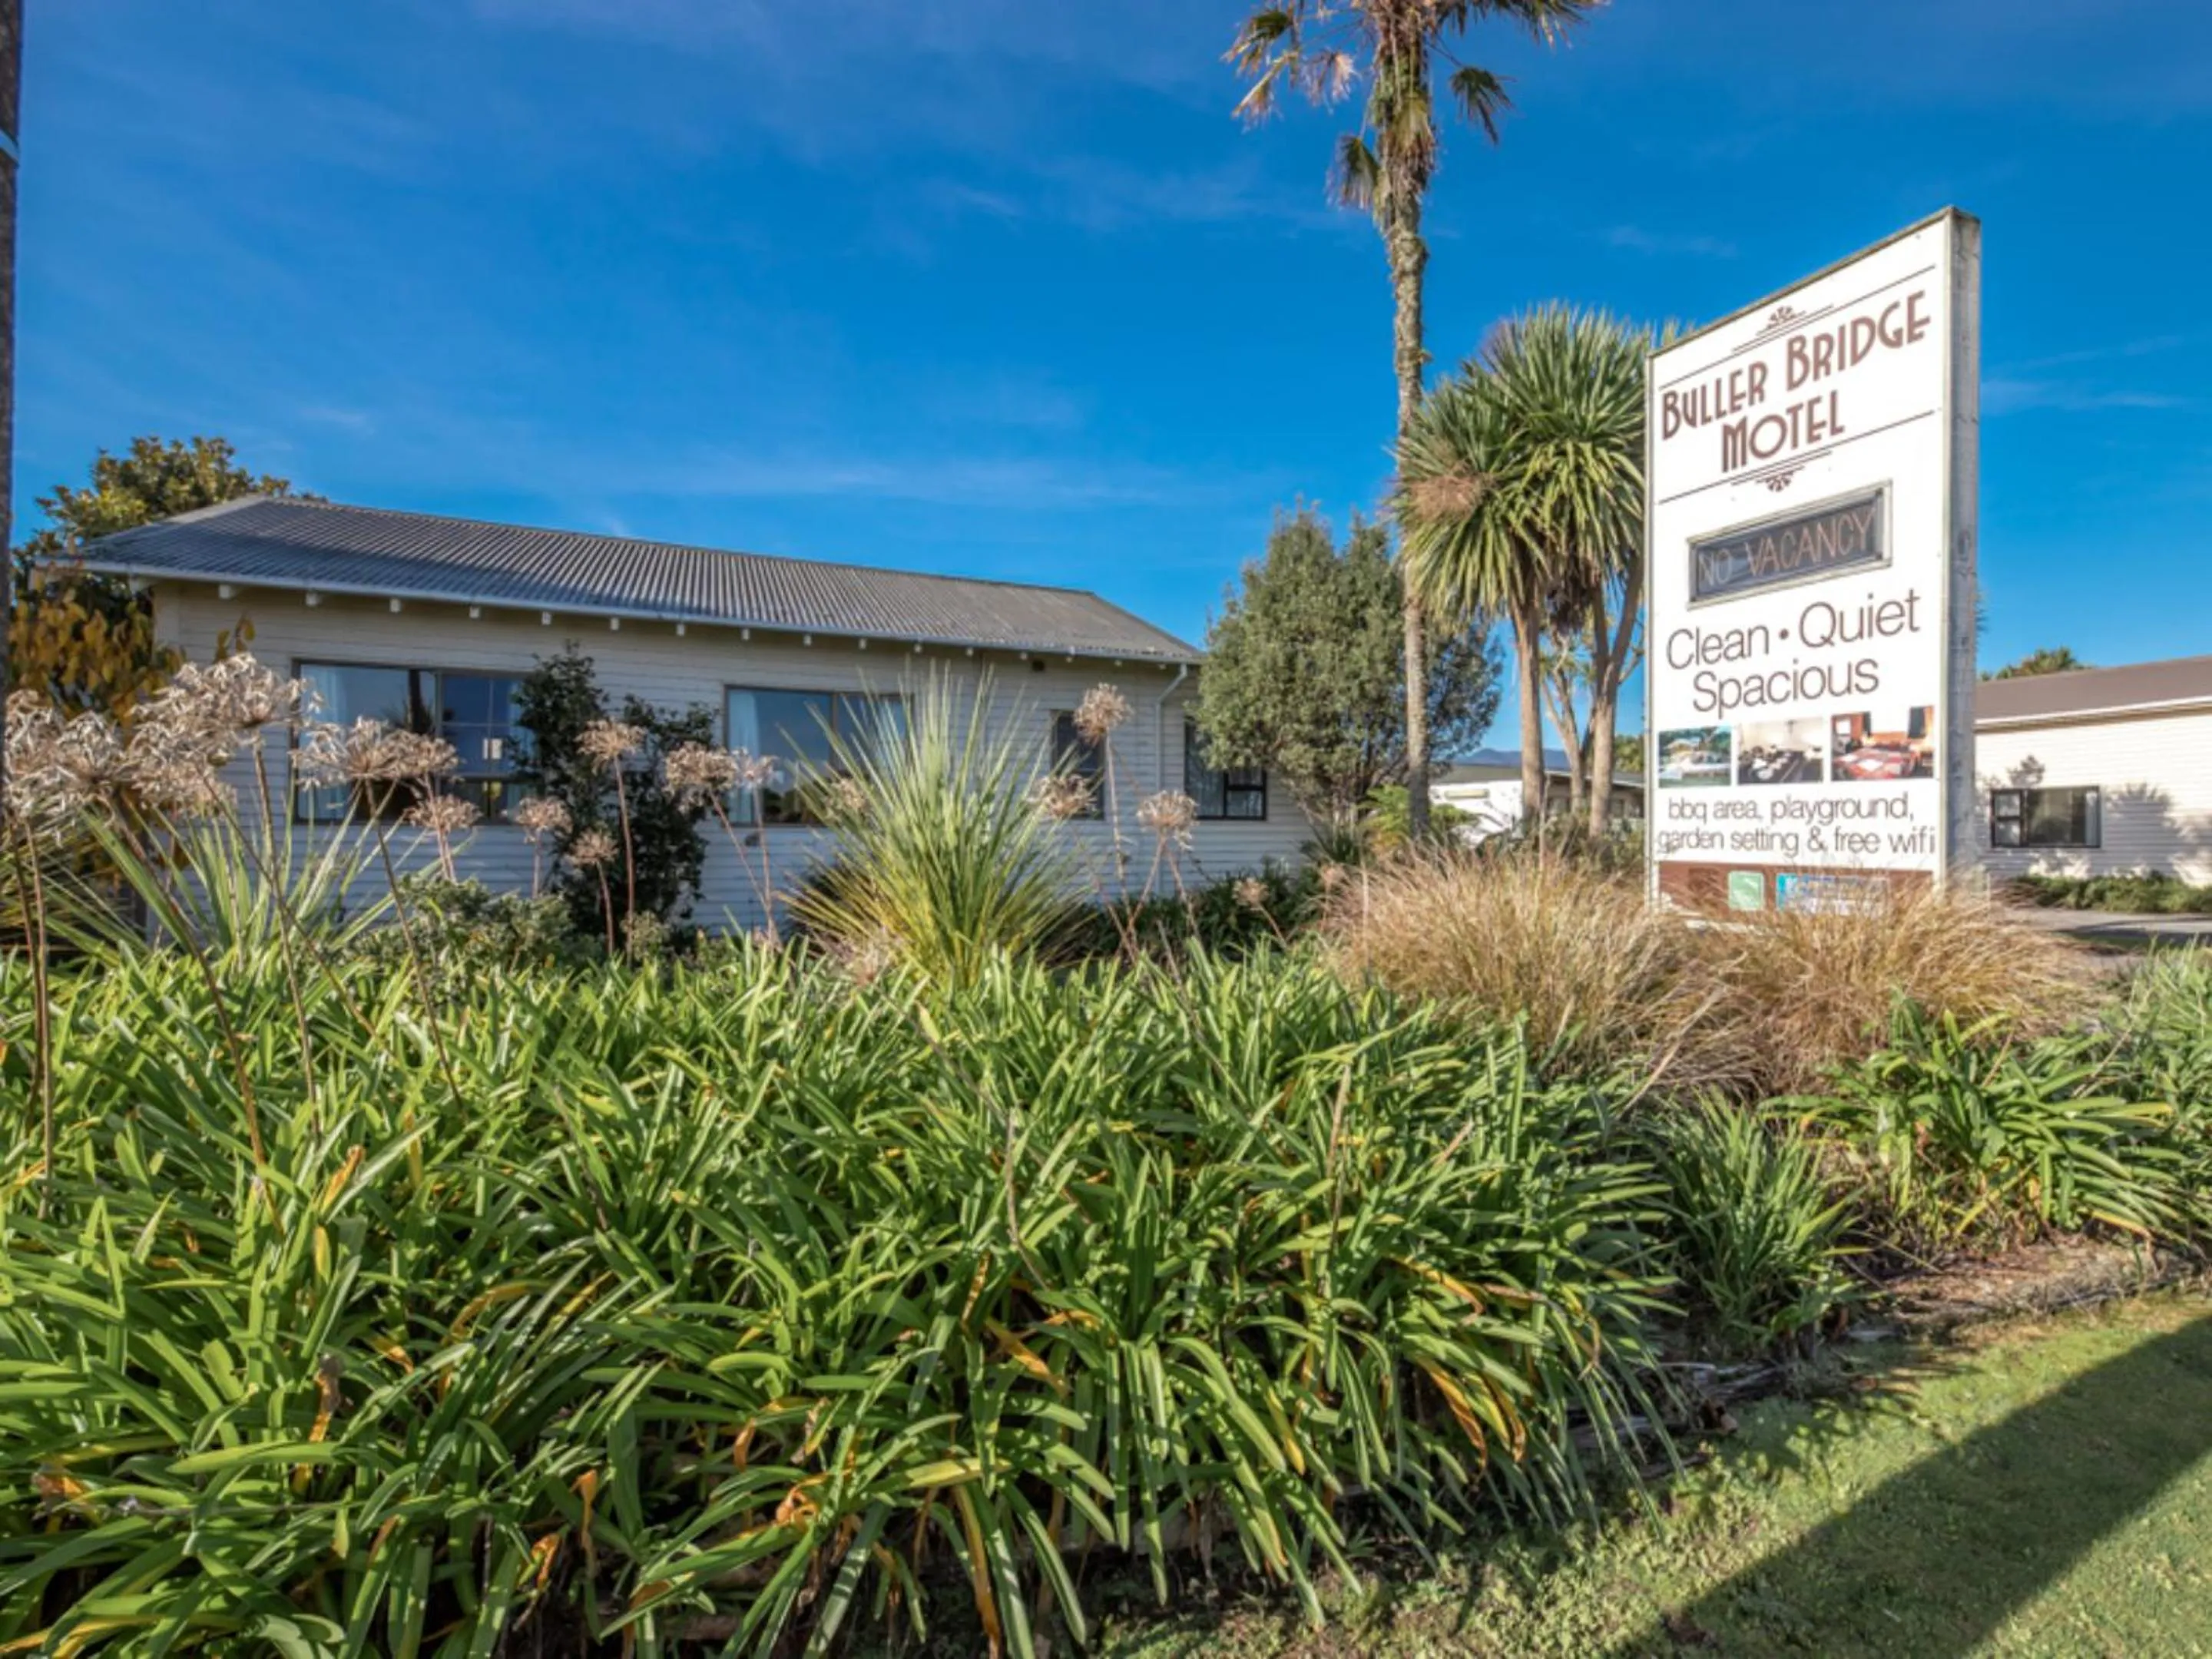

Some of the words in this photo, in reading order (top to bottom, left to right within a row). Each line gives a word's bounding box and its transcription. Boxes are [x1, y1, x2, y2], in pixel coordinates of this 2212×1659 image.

[1662, 362, 1768, 440] BULLER
[1786, 290, 1931, 391] BRIDGE
[1722, 389, 1844, 473] MOTEL
[1698, 548, 1733, 586] NO
[1744, 508, 1876, 576] VACANCY
[1667, 625, 1770, 670] Clean
[1799, 588, 1920, 647] Quiet
[1693, 658, 1879, 720] Spacious
[1656, 827, 1725, 854] garden
[1730, 828, 1800, 857] setting
[1807, 826, 1826, 853] &
[1835, 826, 1881, 853] free
[1888, 826, 1936, 853] wifi
[1668, 796, 1707, 824] bbq
[1770, 792, 1914, 826] playground,
